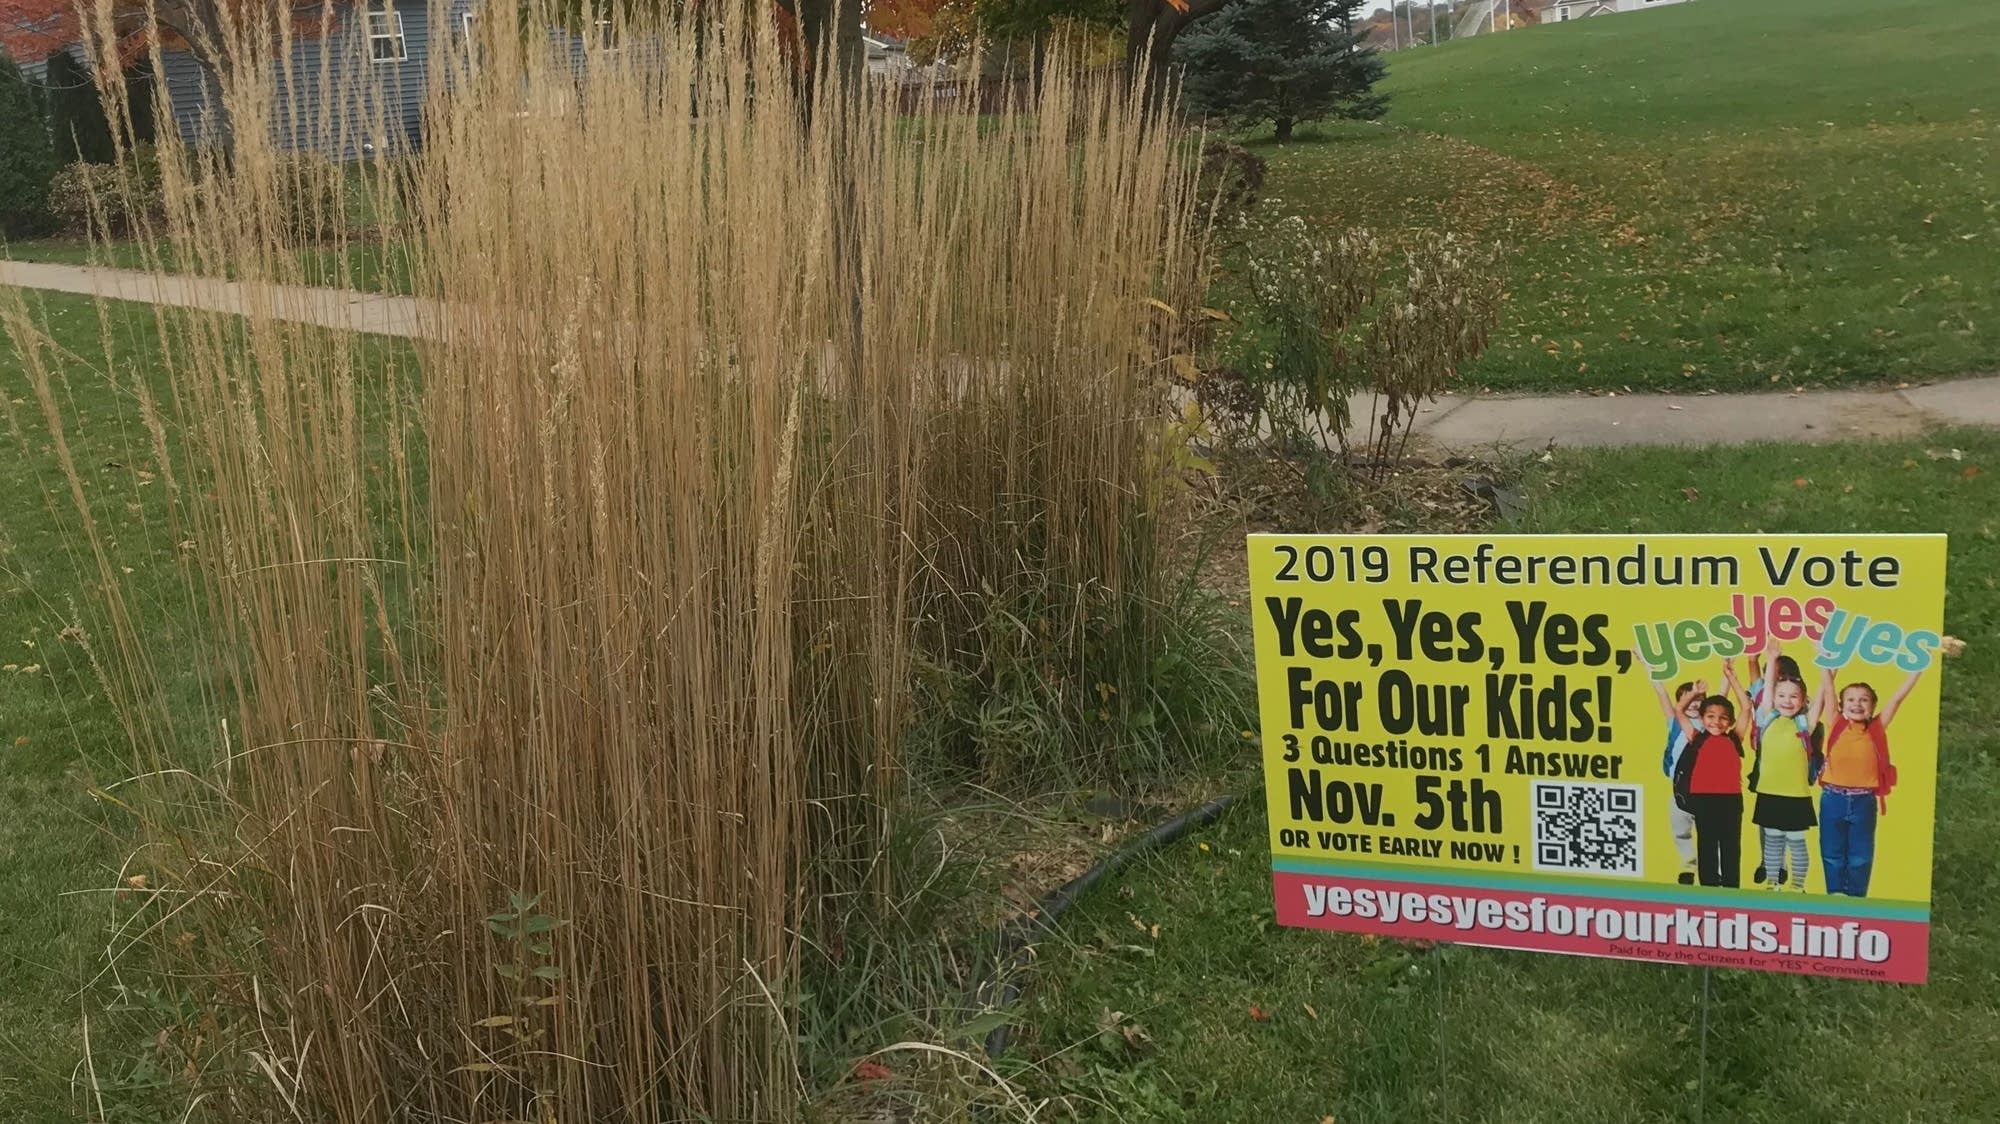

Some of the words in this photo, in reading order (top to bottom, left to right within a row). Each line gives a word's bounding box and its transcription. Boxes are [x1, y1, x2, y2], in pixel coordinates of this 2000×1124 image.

[1273, 545, 1389, 583] 2019
[1410, 543, 1739, 586] Referendum
[1757, 546, 1900, 588] Vote
[1265, 596, 1383, 667] Yes,
[1383, 598, 1505, 670] Yes,
[1505, 600, 1632, 674] Yes,
[1634, 613, 1746, 680] yes
[1730, 593, 1837, 656] yes
[1814, 608, 1942, 672] yes
[1287, 666, 1363, 731] For
[1378, 669, 1470, 737] Our
[1485, 673, 1613, 743] Kids!
[1281, 734, 1300, 763] 3
[1311, 735, 1464, 772] Questions
[1474, 744, 1491, 773] 1
[1504, 745, 1623, 779] Answer
[1287, 768, 1396, 827] Nov.
[1414, 775, 1503, 834] 5th
[1279, 828, 1311, 848] OR
[1317, 831, 1372, 853] VOTE
[1379, 836, 1443, 858] EARLY
[1450, 840, 1505, 863] NOW
[1513, 845, 1521, 864] !
[1303, 884, 1890, 963] yesyesyesforourkids.info
[1609, 944, 1633, 955] Paid
[1637, 946, 1653, 957] for
[1657, 948, 1671, 960] by
[1675, 950, 1694, 960] the
[1697, 951, 1745, 966] Citizens
[1749, 957, 1766, 967] for
[1812, 961, 1886, 976] Committee
